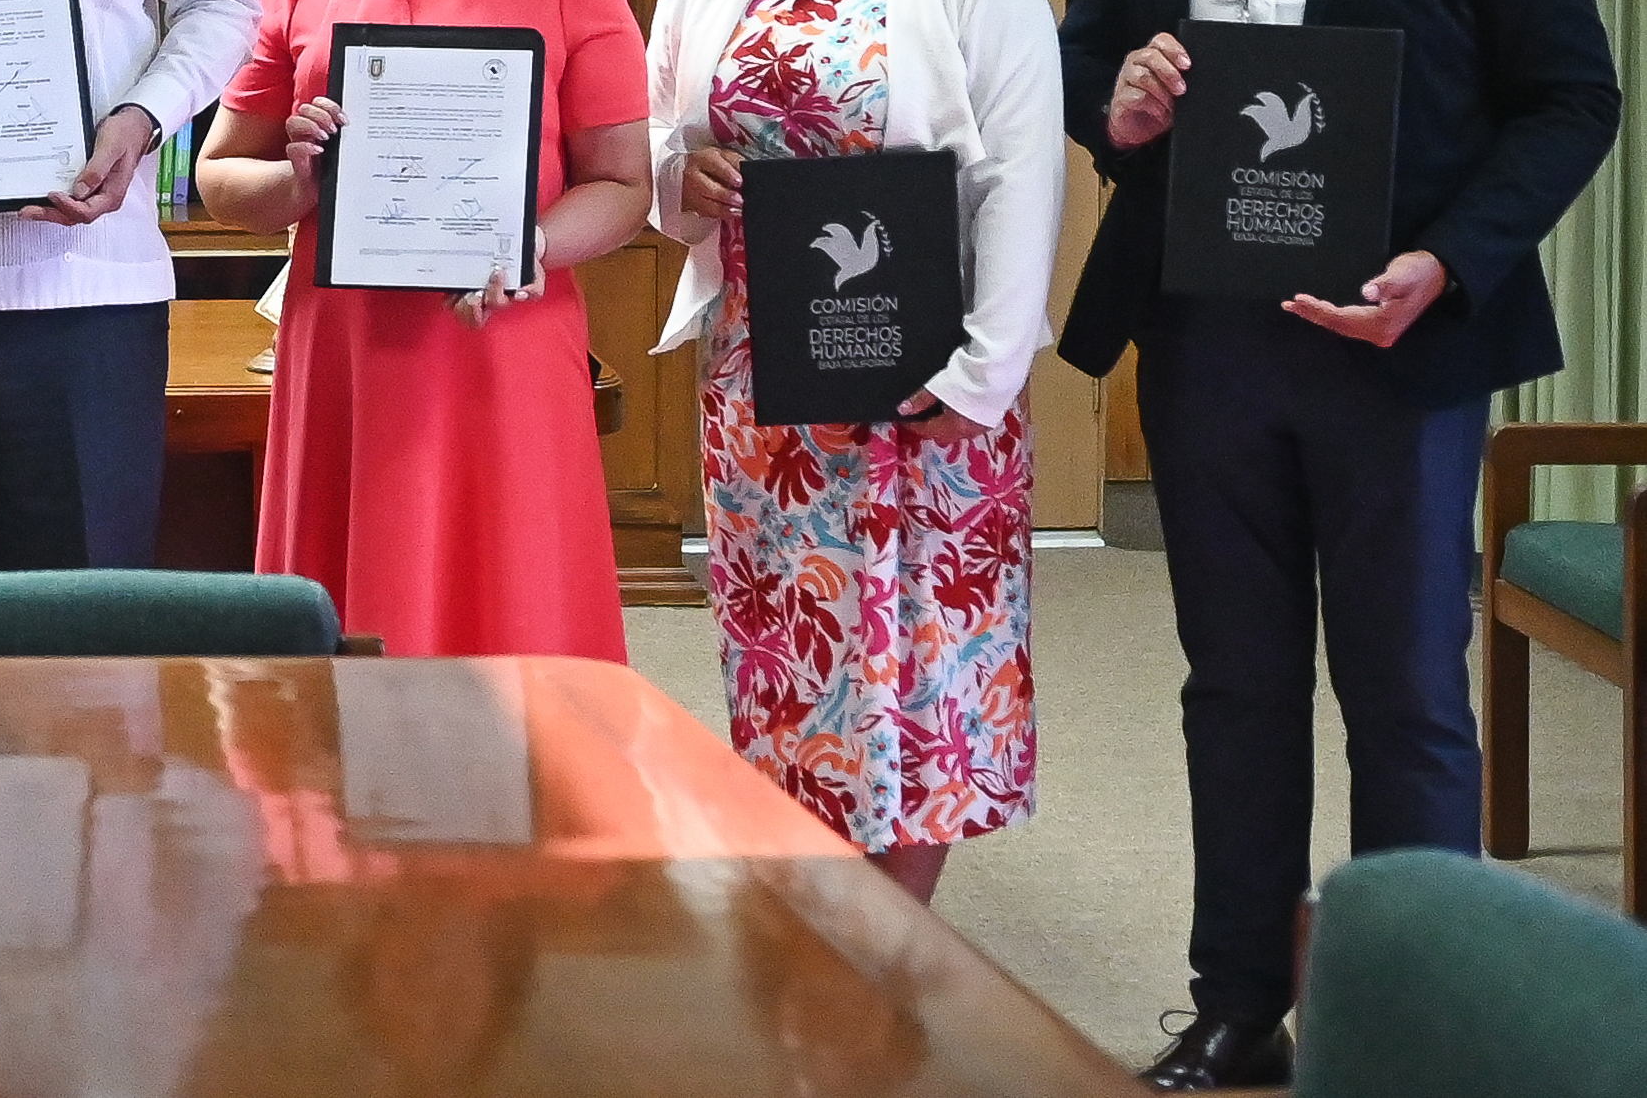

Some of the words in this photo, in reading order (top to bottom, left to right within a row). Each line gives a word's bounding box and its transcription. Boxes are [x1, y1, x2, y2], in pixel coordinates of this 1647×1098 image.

[1226, 198, 1325, 221] DERECHOS
[1226, 215, 1323, 237] HUMANOS
[810, 293, 898, 314] COMISIÓN
[809, 325, 903, 345] DERECHOS
[810, 342, 903, 360] HUMANOS
